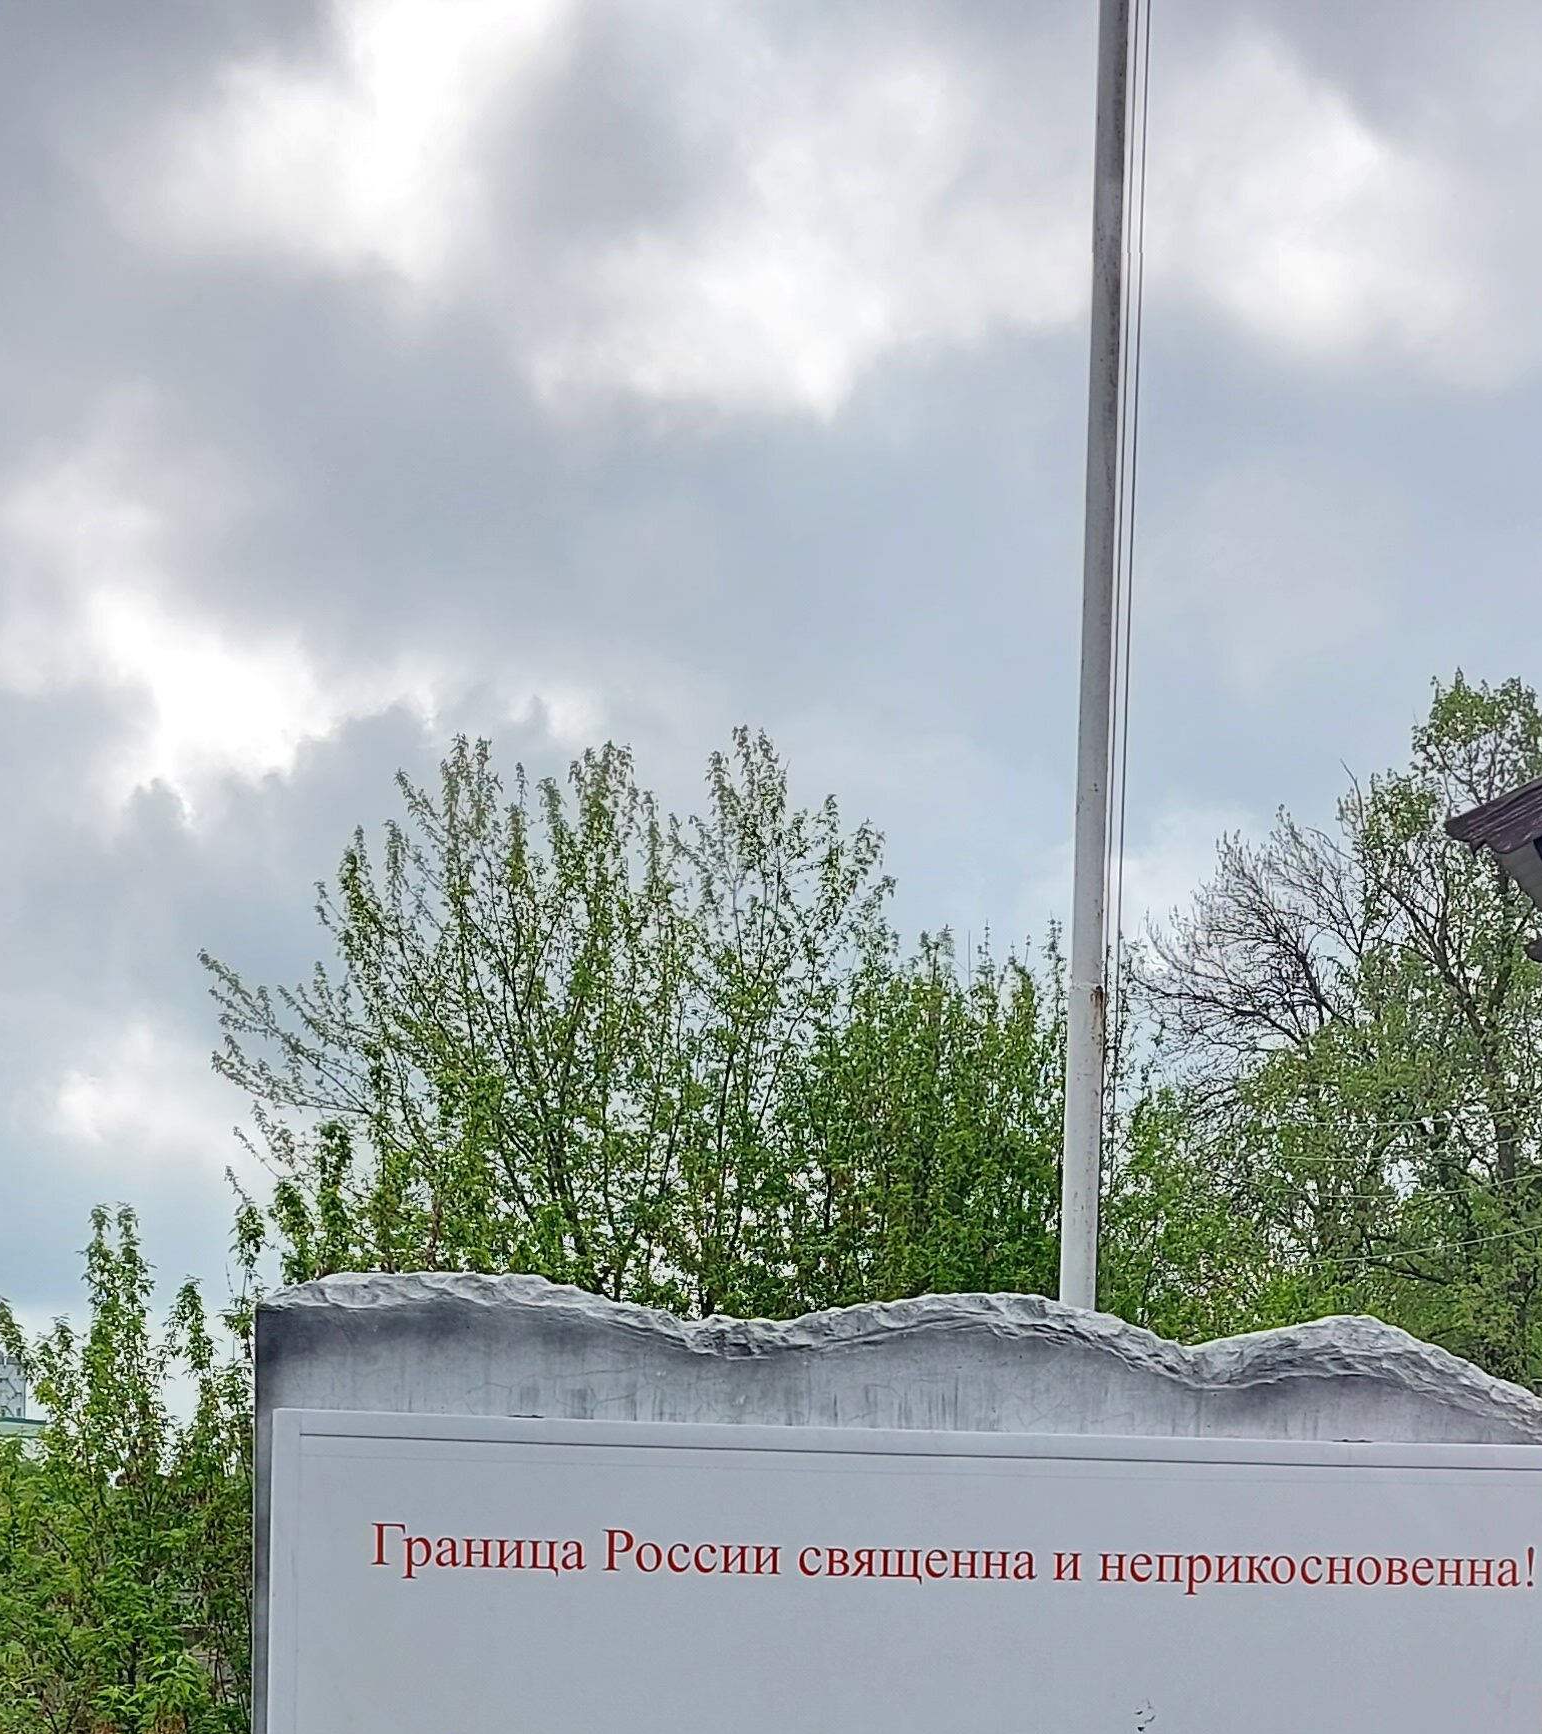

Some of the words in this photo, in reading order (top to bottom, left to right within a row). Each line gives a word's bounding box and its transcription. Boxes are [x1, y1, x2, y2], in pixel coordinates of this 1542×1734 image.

[371, 1522, 586, 1582] Граница
[604, 1528, 781, 1576] России
[797, 1547, 1036, 1586] священна
[1053, 1550, 1083, 1583] и
[1099, 1547, 1535, 1596] неприкосновенна!
